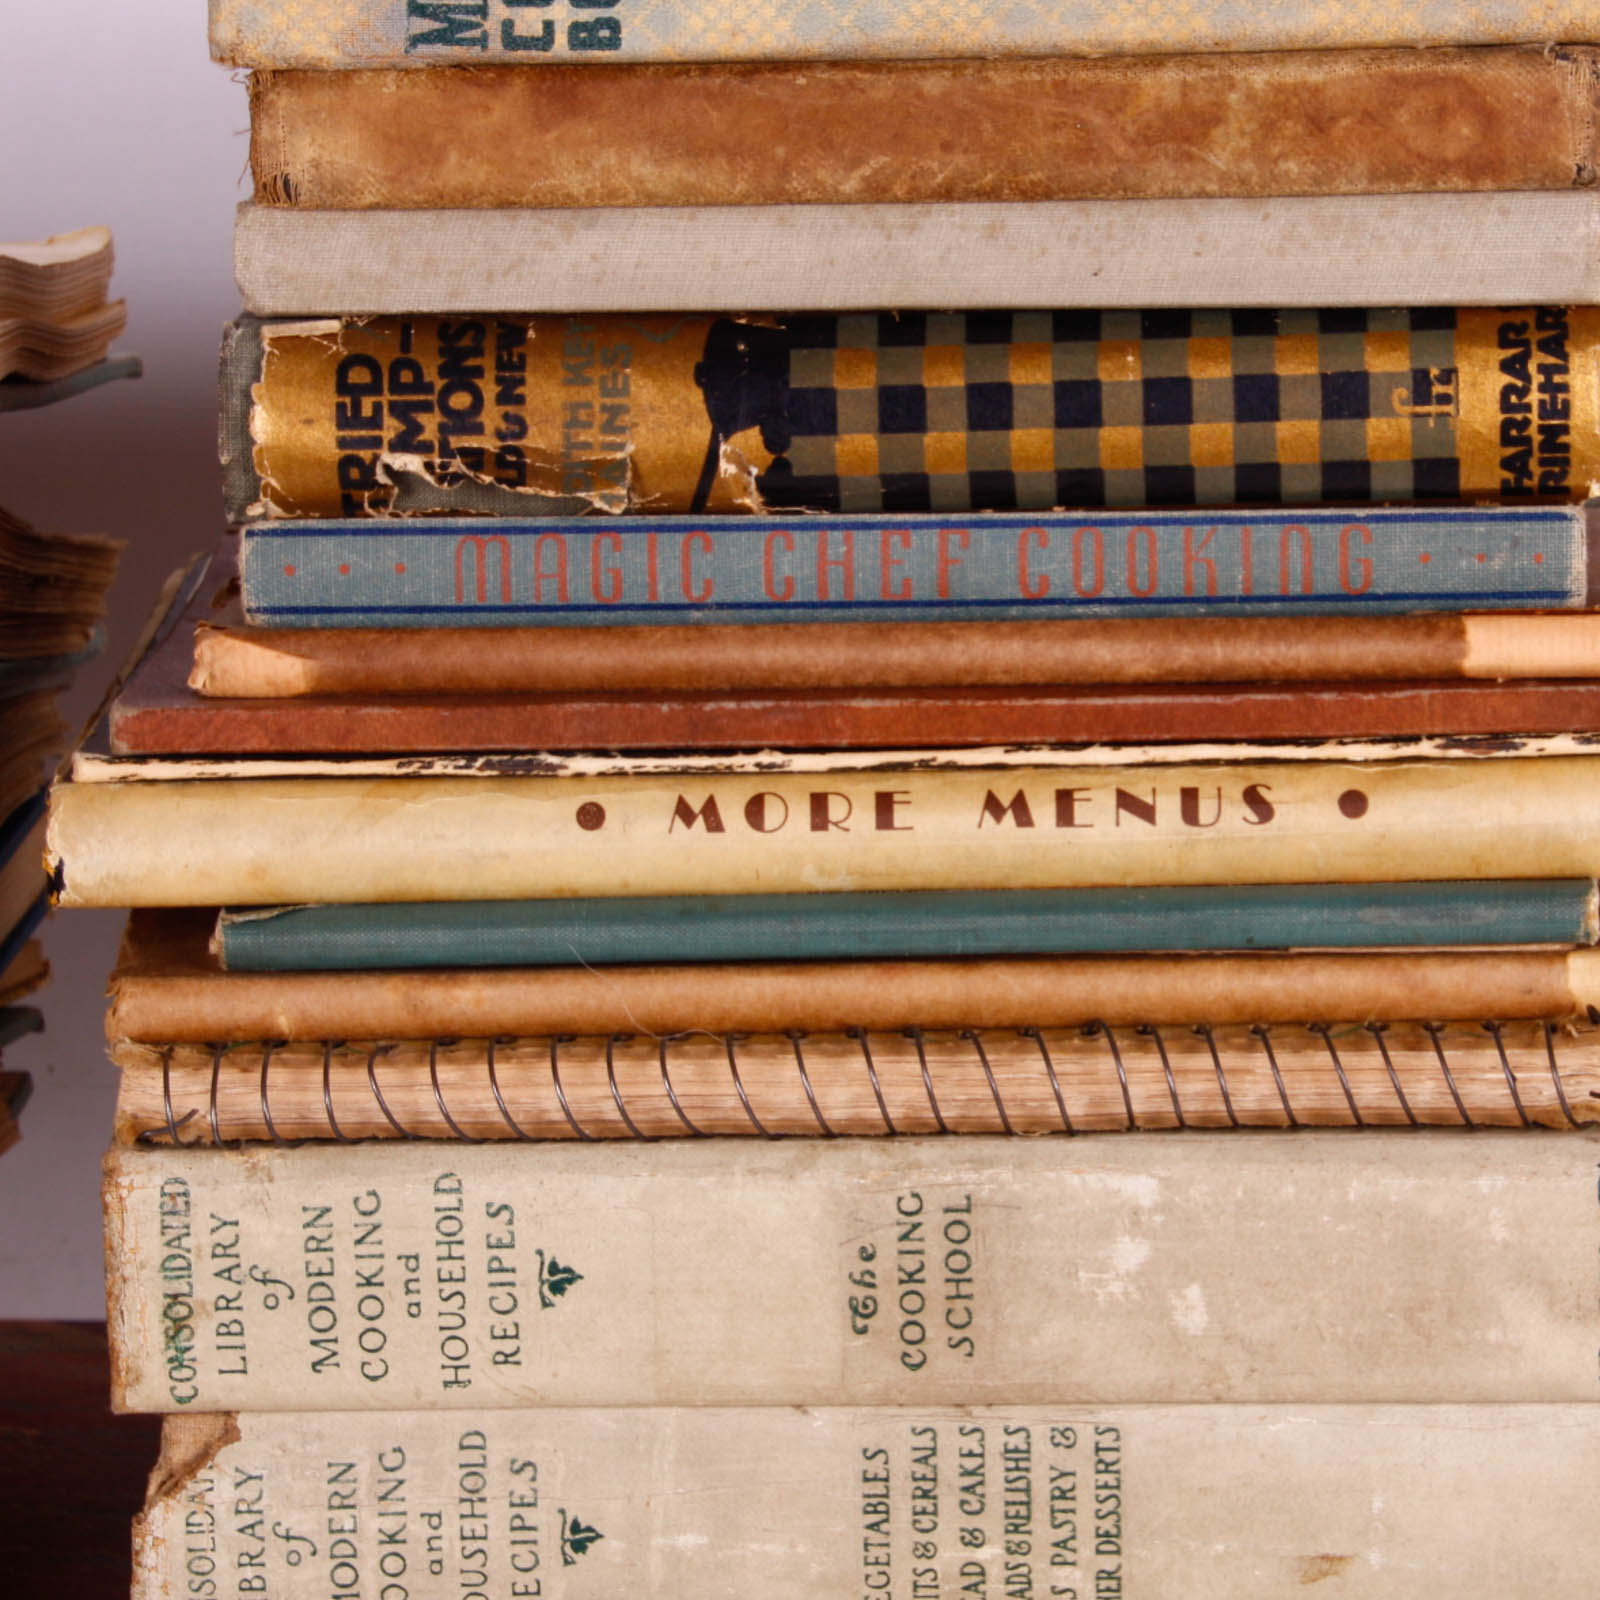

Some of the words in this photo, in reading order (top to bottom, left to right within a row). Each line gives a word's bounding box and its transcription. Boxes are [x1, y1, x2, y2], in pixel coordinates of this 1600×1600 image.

[501, 0, 555, 52] C
[567, 0, 622, 52] B
[494, 321, 528, 405] NEW
[1498, 321, 1532, 497] FARRAR
[455, 530, 715, 603] MAGIC
[763, 528, 971, 602] CHEF
[1016, 523, 1374, 599] COOKING
[668, 790, 915, 834] MORE
[977, 783, 1276, 830] MENUS
[160, 1176, 199, 1405] CONSOLIDATED
[209, 1212, 248, 1376] LIBRARY
[249, 1263, 295, 1311] of
[302, 1205, 340, 1374] MODERN
[353, 1189, 389, 1382] COOKING
[397, 1252, 422, 1319] and
[433, 1171, 471, 1390] HOUSEHOLD
[486, 1201, 522, 1367] RECIPES
[849, 1243, 878, 1336] The
[896, 1190, 928, 1371] COOKING
[943, 1193, 974, 1358] SCHOOL
[911, 1425, 939, 1534] CEREALS
[959, 1425, 985, 1516] CAKES
[1004, 1425, 1032, 1536] RELISHES
[1050, 1425, 1078, 1449] &
[510, 1458, 541, 1598] ECIPES
[959, 1527, 987, 1548] &
[1050, 1465, 1077, 1568] PASTRY
[1095, 1425, 1121, 1557] DESSERTS
[272, 1521, 317, 1567] of
[420, 1510, 444, 1577] and
[912, 1541, 939, 1560] &
[1004, 1540, 1032, 1557] &
